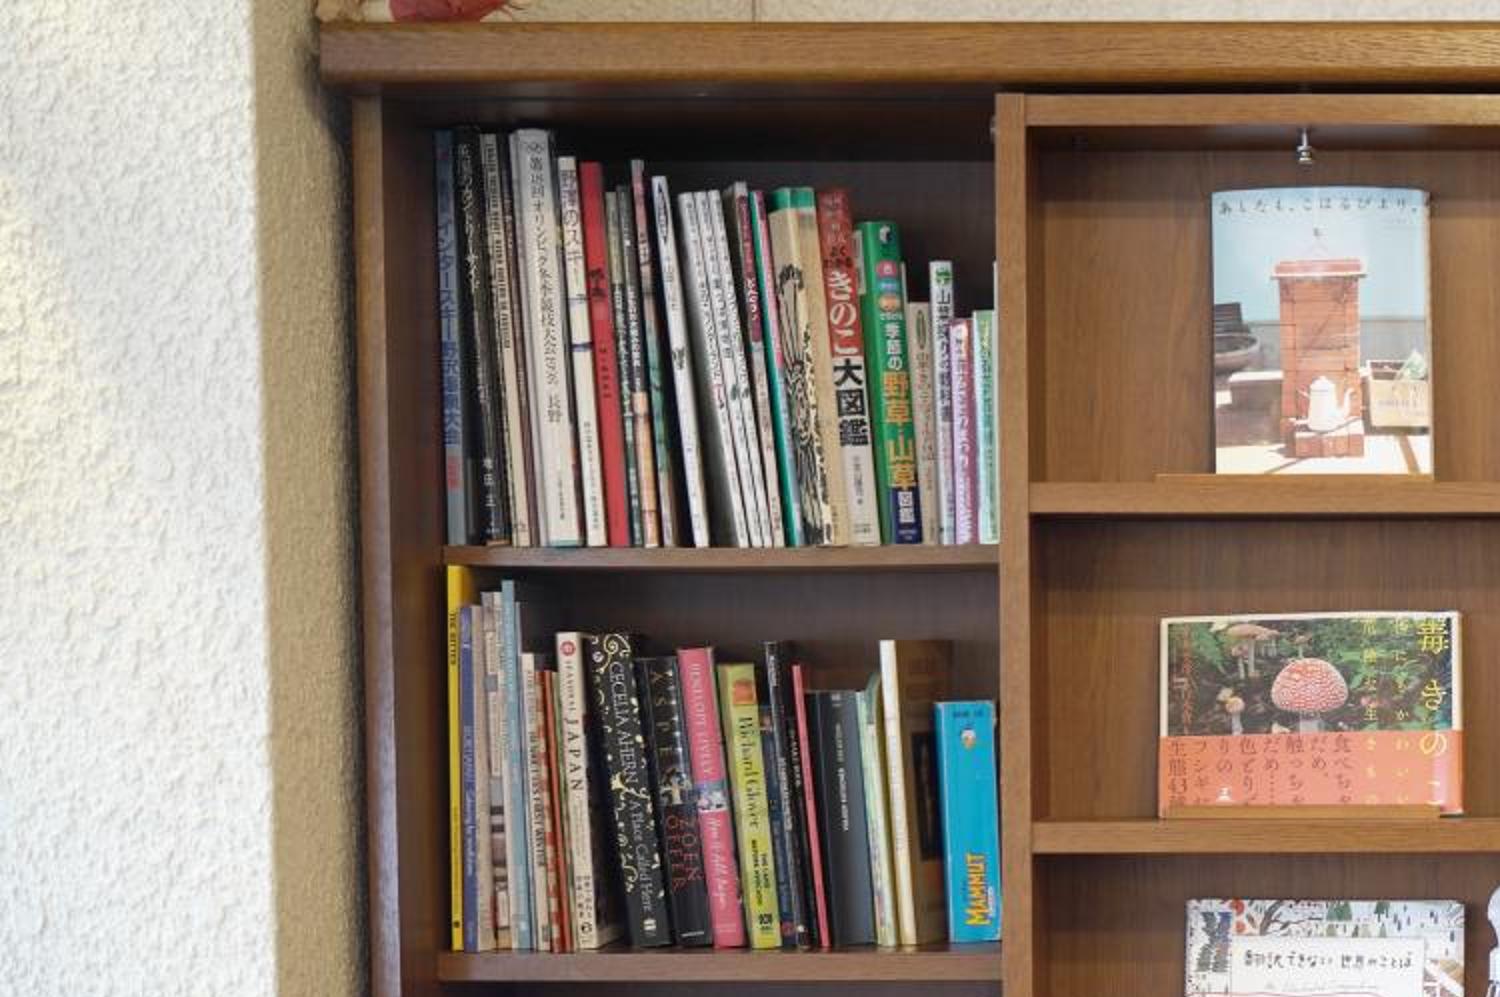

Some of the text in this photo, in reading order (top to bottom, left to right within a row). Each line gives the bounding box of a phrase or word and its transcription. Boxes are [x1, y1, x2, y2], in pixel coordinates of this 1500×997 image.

[827, 271, 869, 447] きのこ大図鑑
[609, 661, 639, 784] CECELIA AHERN
[1415, 617, 1450, 805] 毒きのこ
[565, 719, 584, 791] JAPAN
[630, 811, 645, 841] Place
[635, 843, 650, 881] Called
[640, 882, 652, 913] Here
[964, 852, 991, 927] MAMMUT
